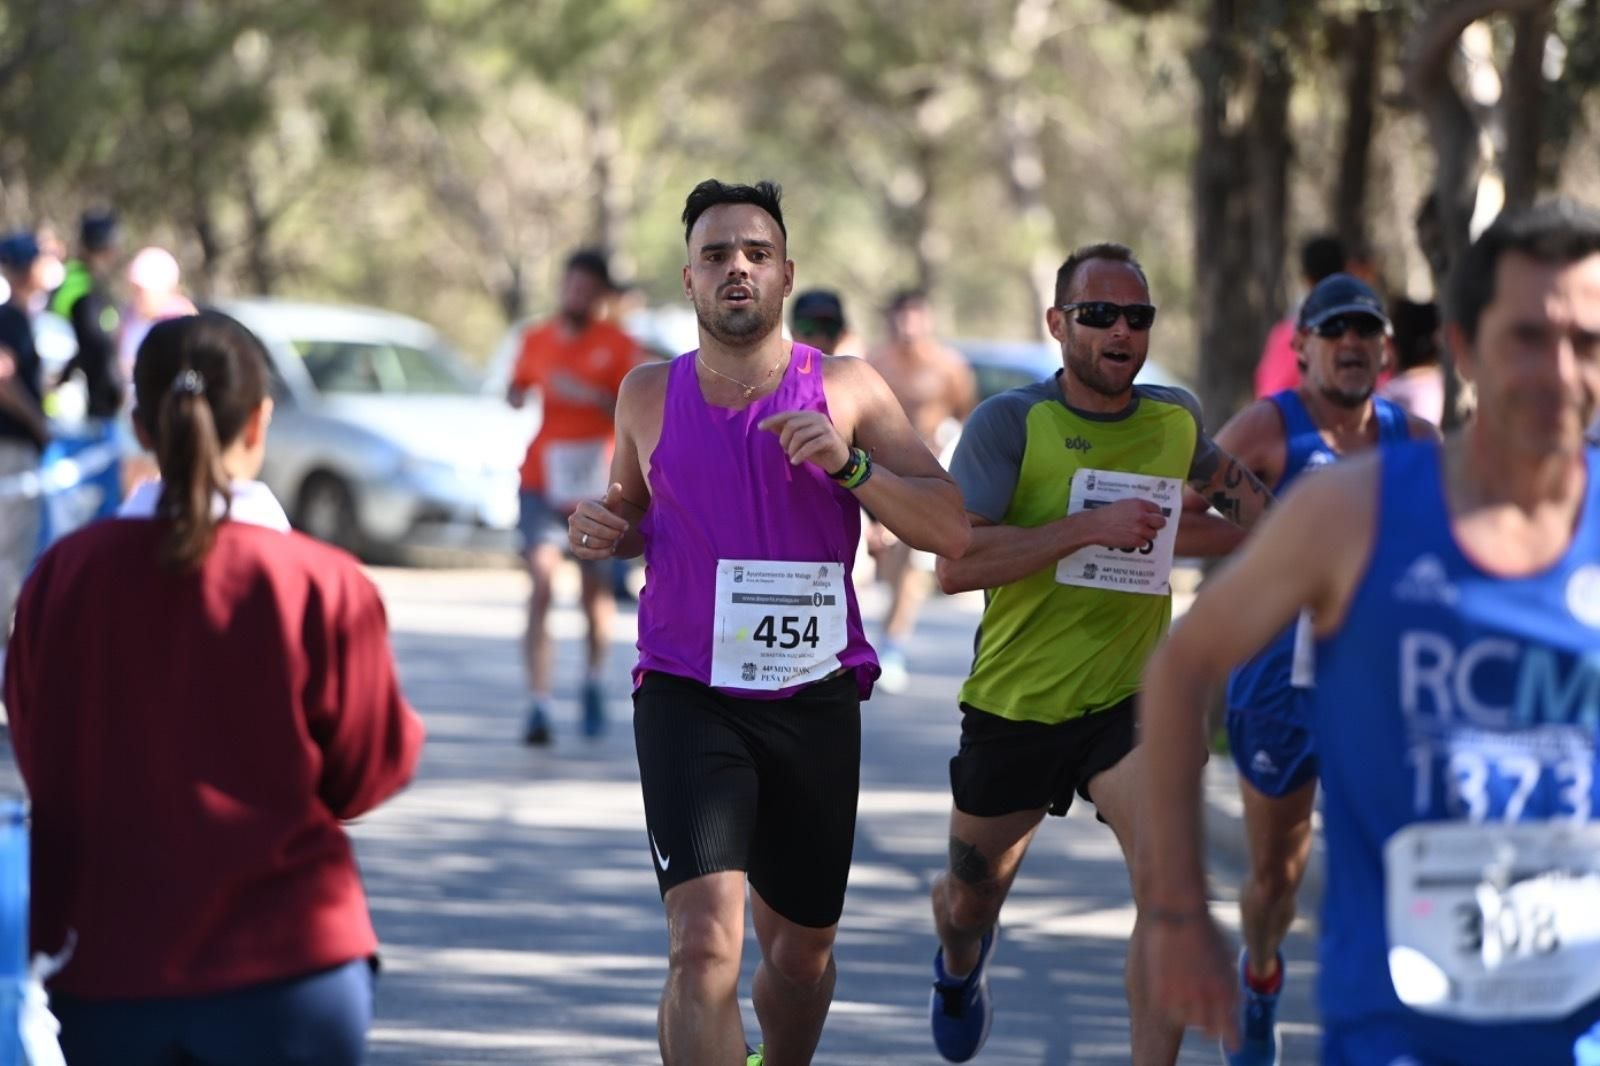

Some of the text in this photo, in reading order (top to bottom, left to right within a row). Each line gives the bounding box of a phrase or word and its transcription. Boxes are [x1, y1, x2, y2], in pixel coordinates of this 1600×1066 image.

[753, 615, 820, 649] 454
[774, 665, 791, 673] MINI
[1401, 631, 1600, 732] RCM
